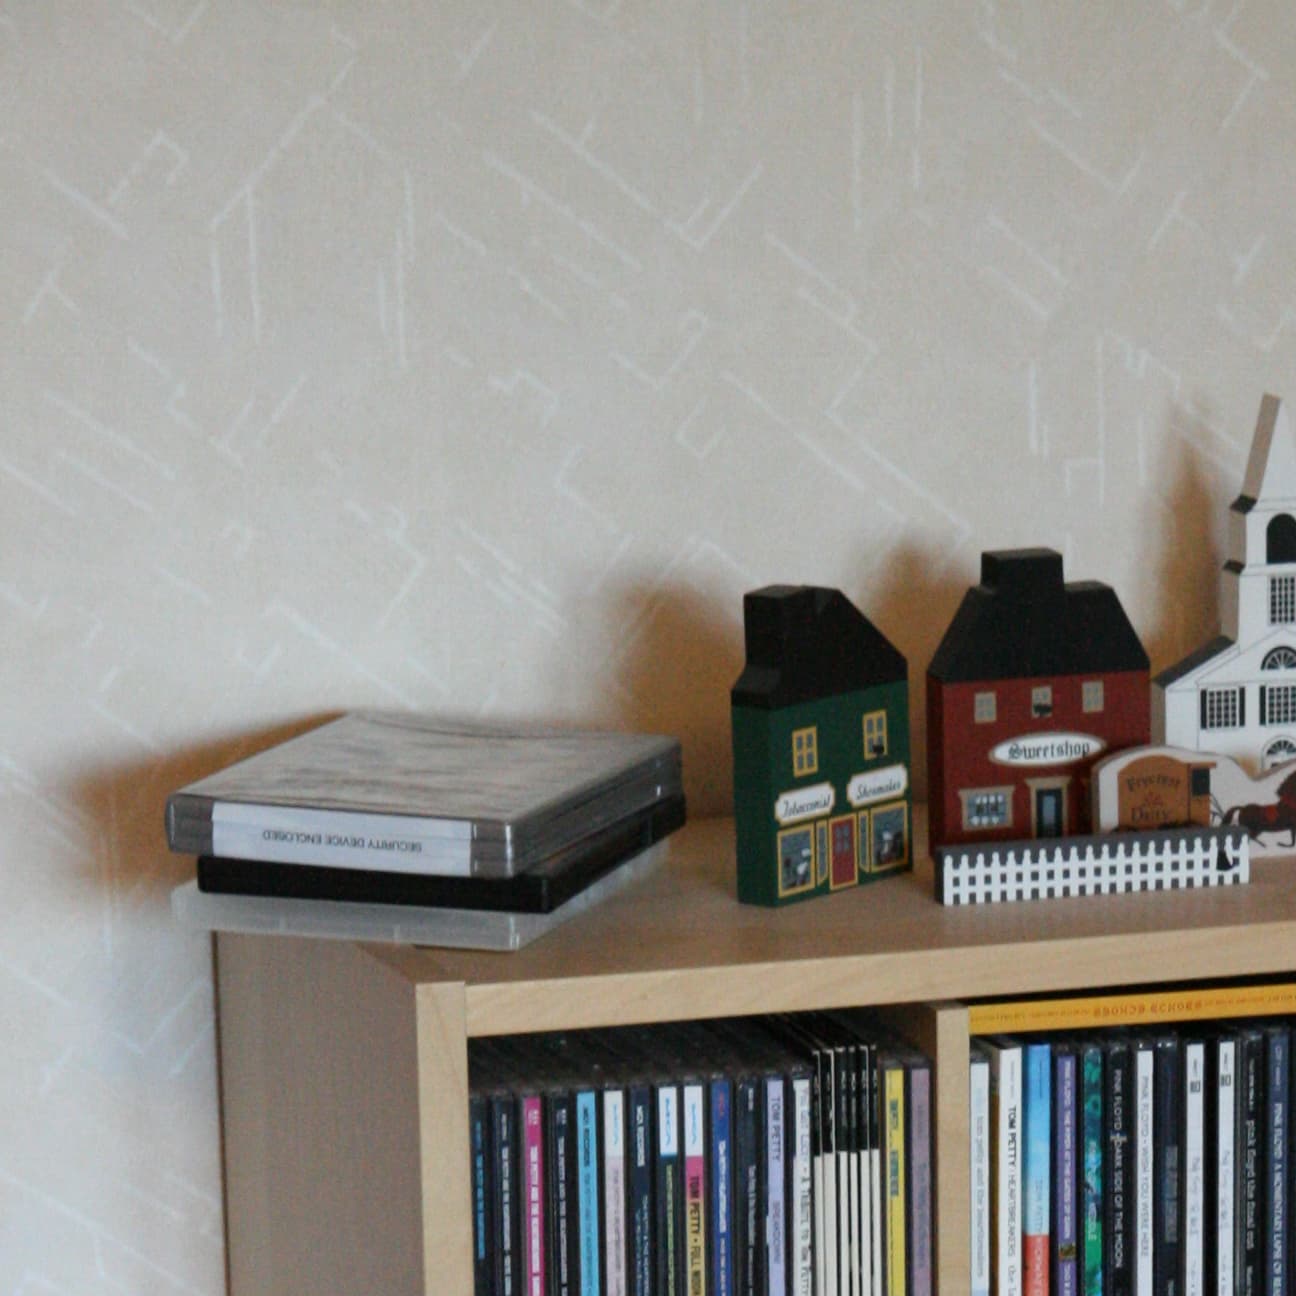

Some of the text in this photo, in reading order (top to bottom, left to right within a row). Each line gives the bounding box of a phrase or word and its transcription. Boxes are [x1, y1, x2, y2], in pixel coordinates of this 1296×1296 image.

[1008, 740, 1090, 760] Sweetshop
[263, 830, 422, 852] SECURITY DEVICE ENCLOSED
[1007, 1106, 1016, 1167] TOM PETTY
[689, 1176, 699, 1196] TOM
[690, 1200, 700, 1237] PETTY
[690, 1246, 701, 1267] FULL
[690, 1270, 701, 1296] MOON
